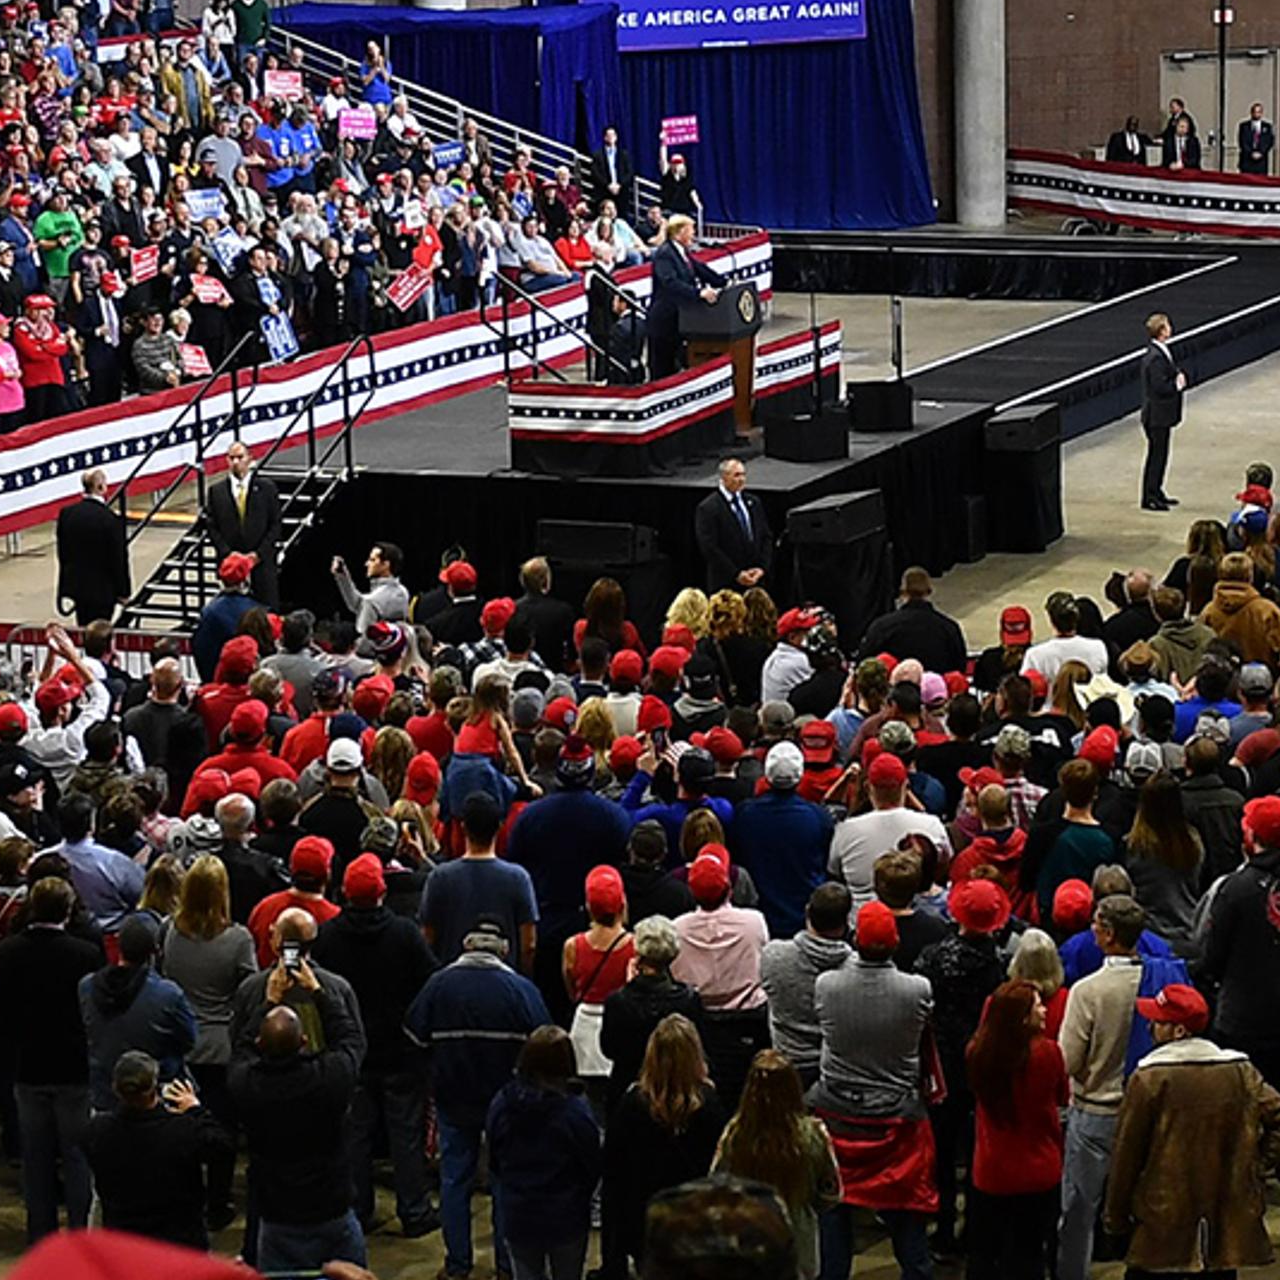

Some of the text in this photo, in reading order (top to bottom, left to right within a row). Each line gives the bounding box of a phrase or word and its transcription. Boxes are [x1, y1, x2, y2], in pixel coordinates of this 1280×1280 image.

[644, 8, 727, 27] AMERICA
[732, 6, 791, 24] GREAT
[796, 0, 860, 19] AGAIN!
